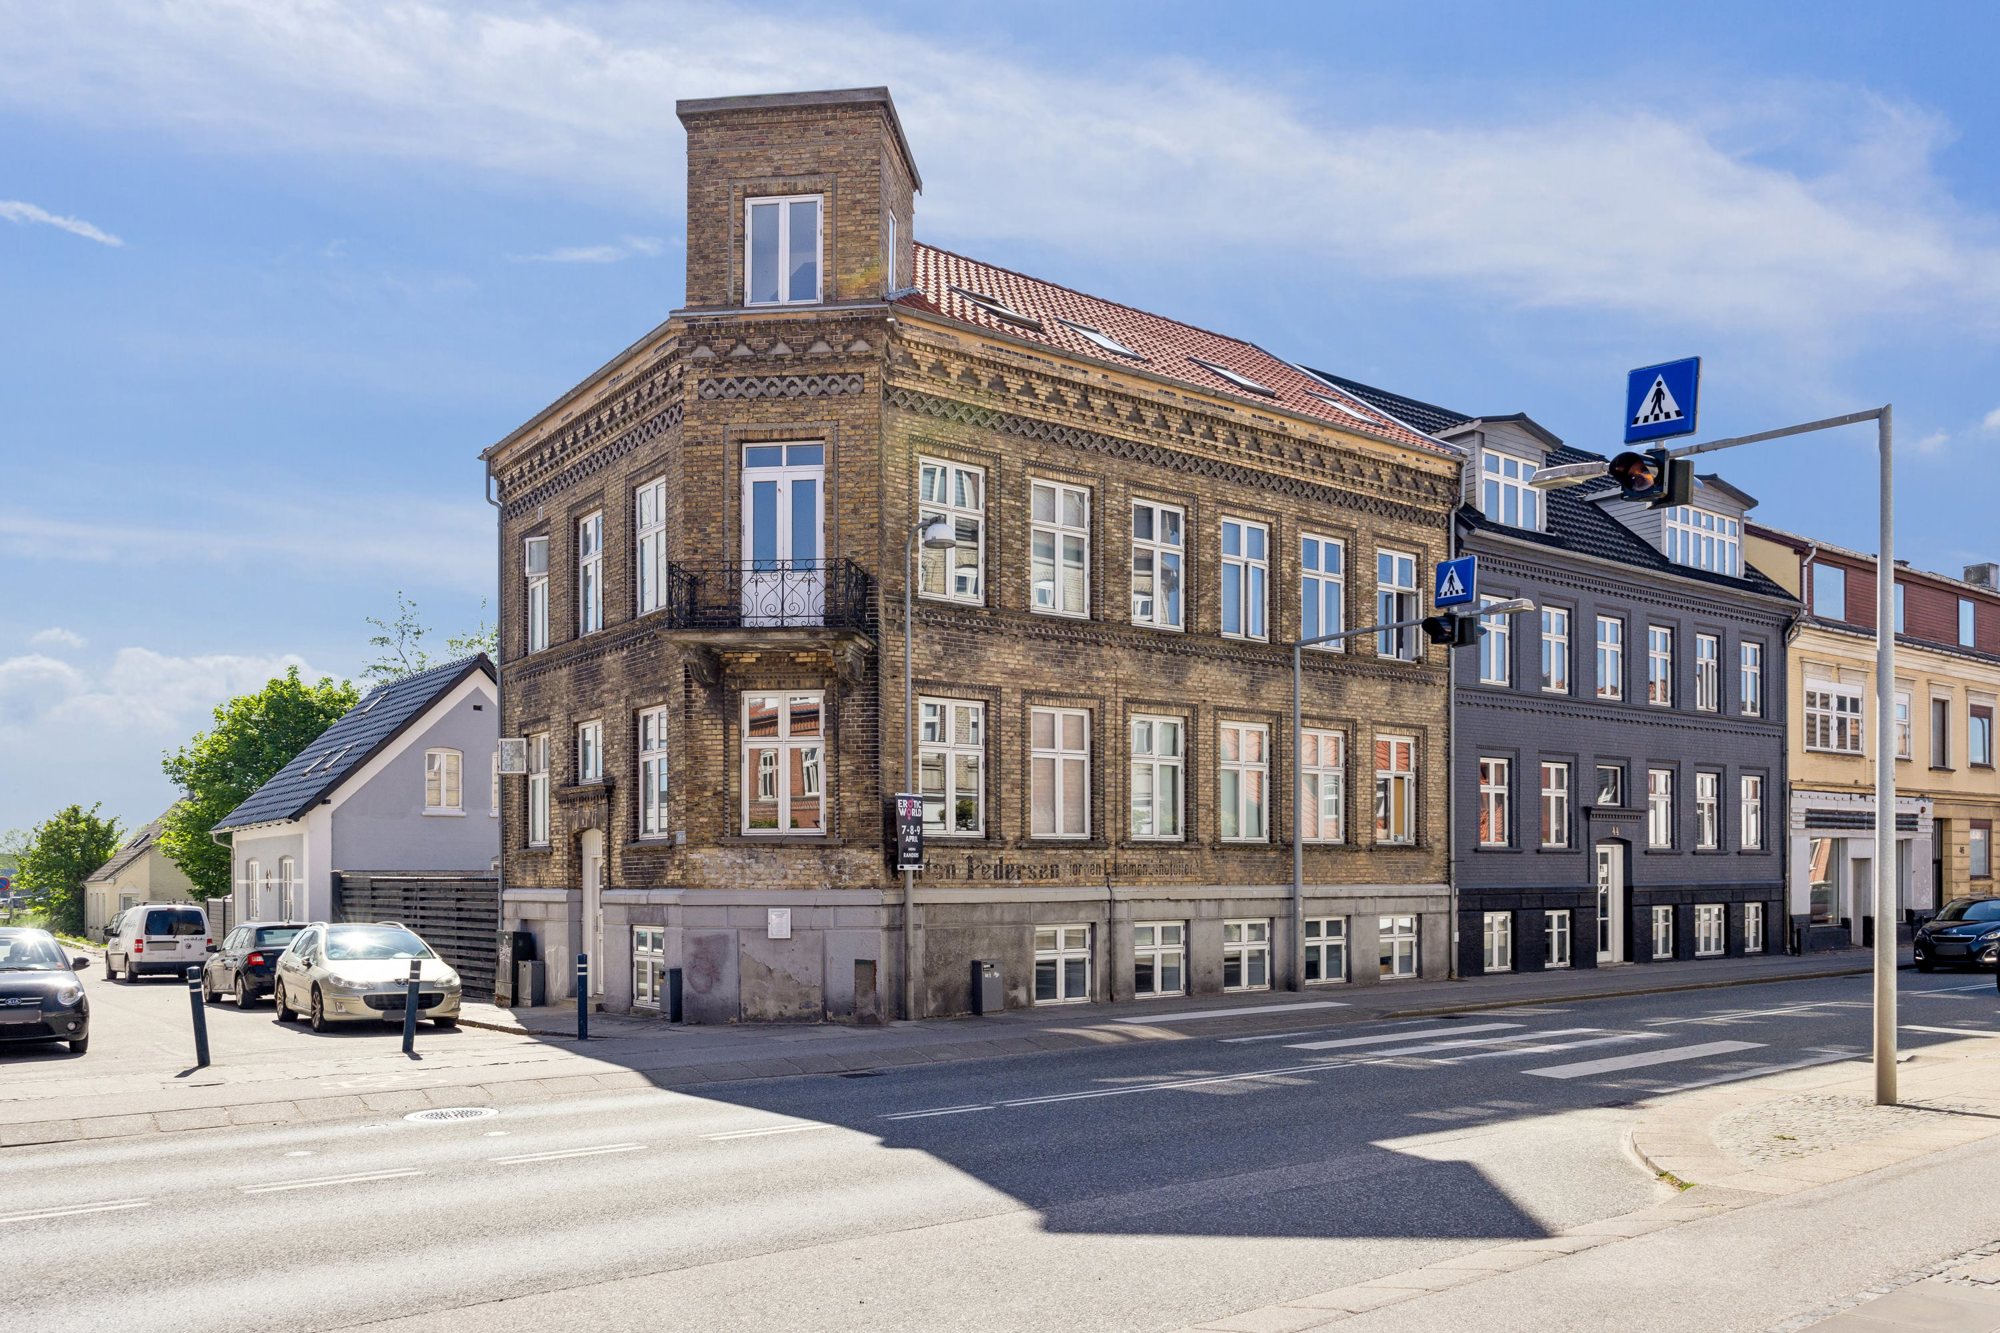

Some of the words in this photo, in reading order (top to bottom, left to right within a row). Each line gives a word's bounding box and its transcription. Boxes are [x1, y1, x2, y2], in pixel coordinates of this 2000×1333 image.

[898, 799, 922, 808] EROTIC
[898, 808, 922, 817] WORLD
[965, 854, 1060, 880] Pedersen
